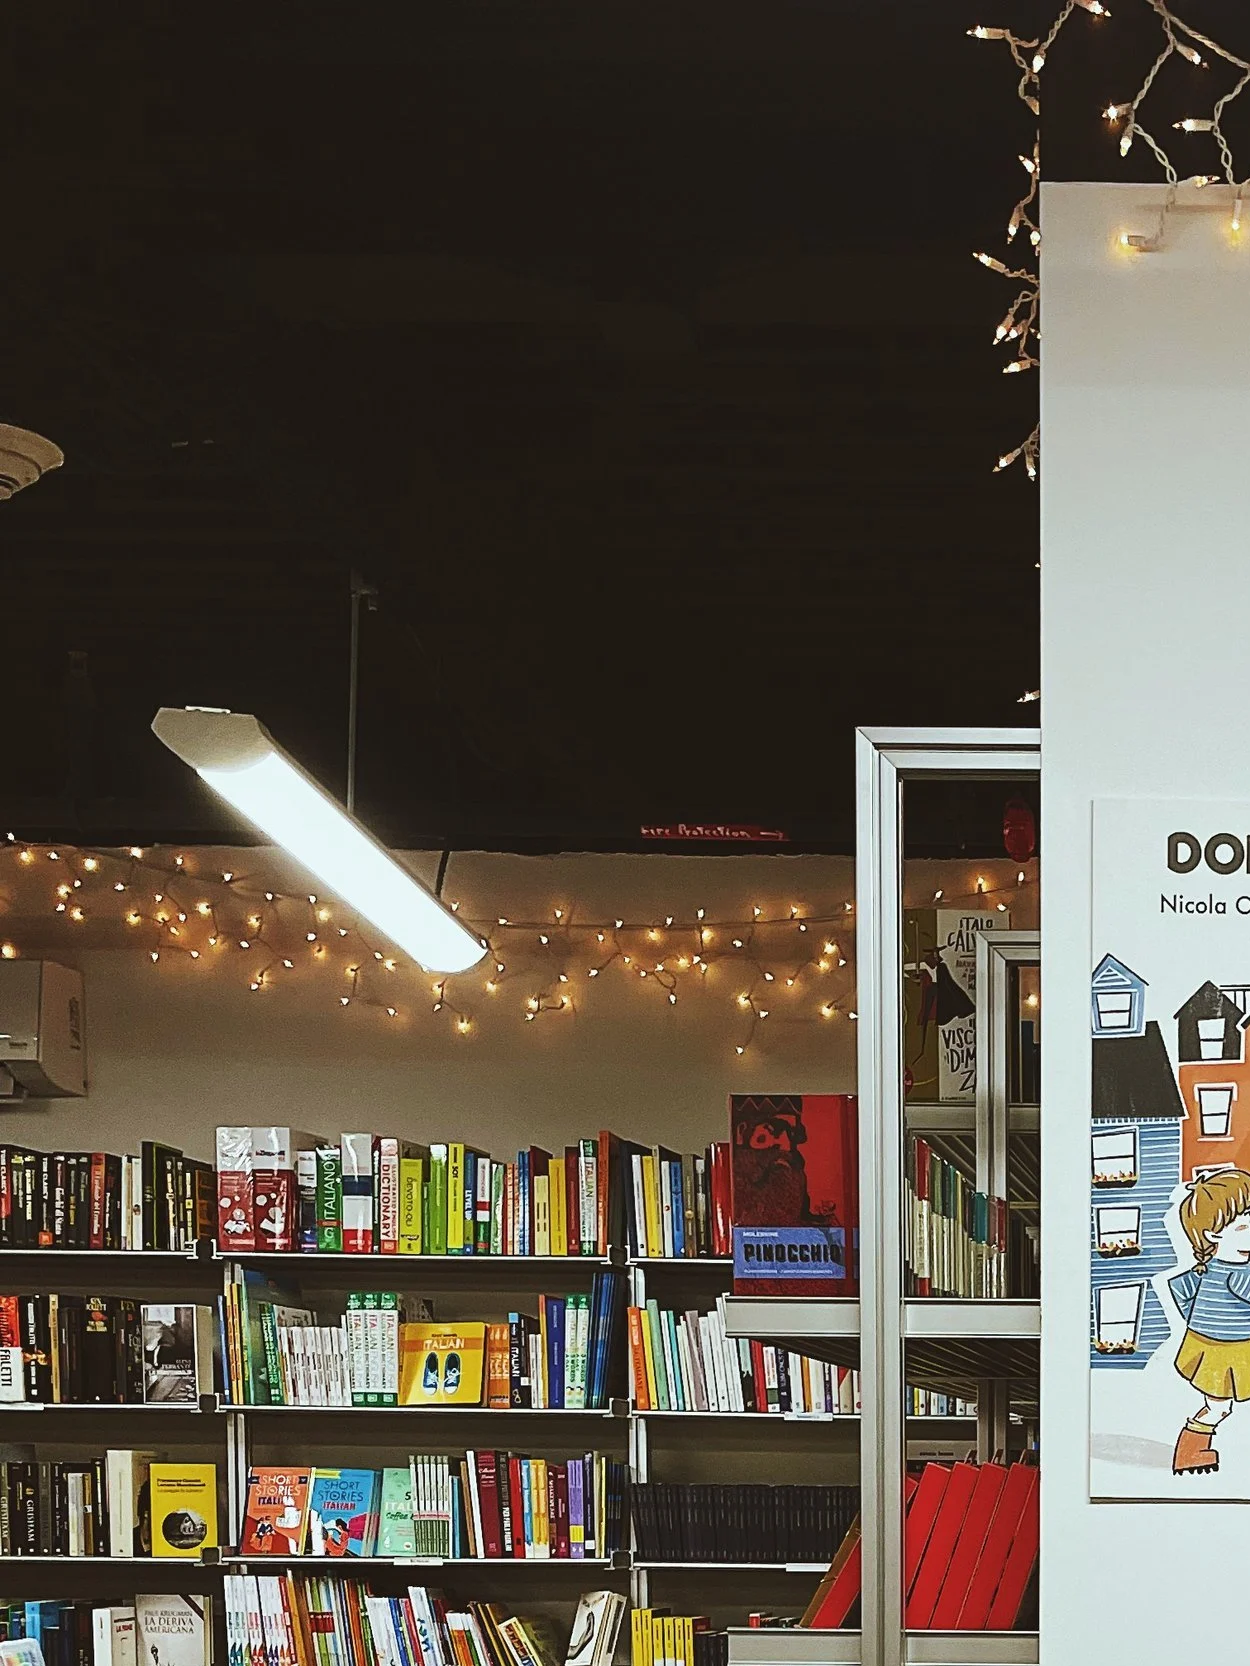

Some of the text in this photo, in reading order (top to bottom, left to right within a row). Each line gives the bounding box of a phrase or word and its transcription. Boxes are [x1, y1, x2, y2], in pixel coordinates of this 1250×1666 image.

[1160, 893, 1227, 916] Nicola
[959, 916, 994, 932] ITALO
[941, 1026, 977, 1050] VISC
[381, 1164, 391, 1238] DICTIONARY
[743, 1243, 842, 1264] PINOCCHIO
[353, 1314, 361, 1350] ITALIAN
[369, 1314, 377, 1350] ITALIAN
[386, 1314, 395, 1350] ITALIAN
[424, 1338, 465, 1349] ITALIAN
[511, 1347, 520, 1377] ITALIAN
[262, 1475, 298, 1485] SHORT
[324, 1480, 360, 1490] SHORT
[255, 1485, 301, 1496] STORIES
[318, 1491, 364, 1502] STORIES
[385, 1502, 413, 1511] ITAL
[26, 1500, 35, 1542] GRISHAM
[144, 1617, 194, 1626] LA DERIVA
[144, 1626, 195, 1634] AMERICANA
